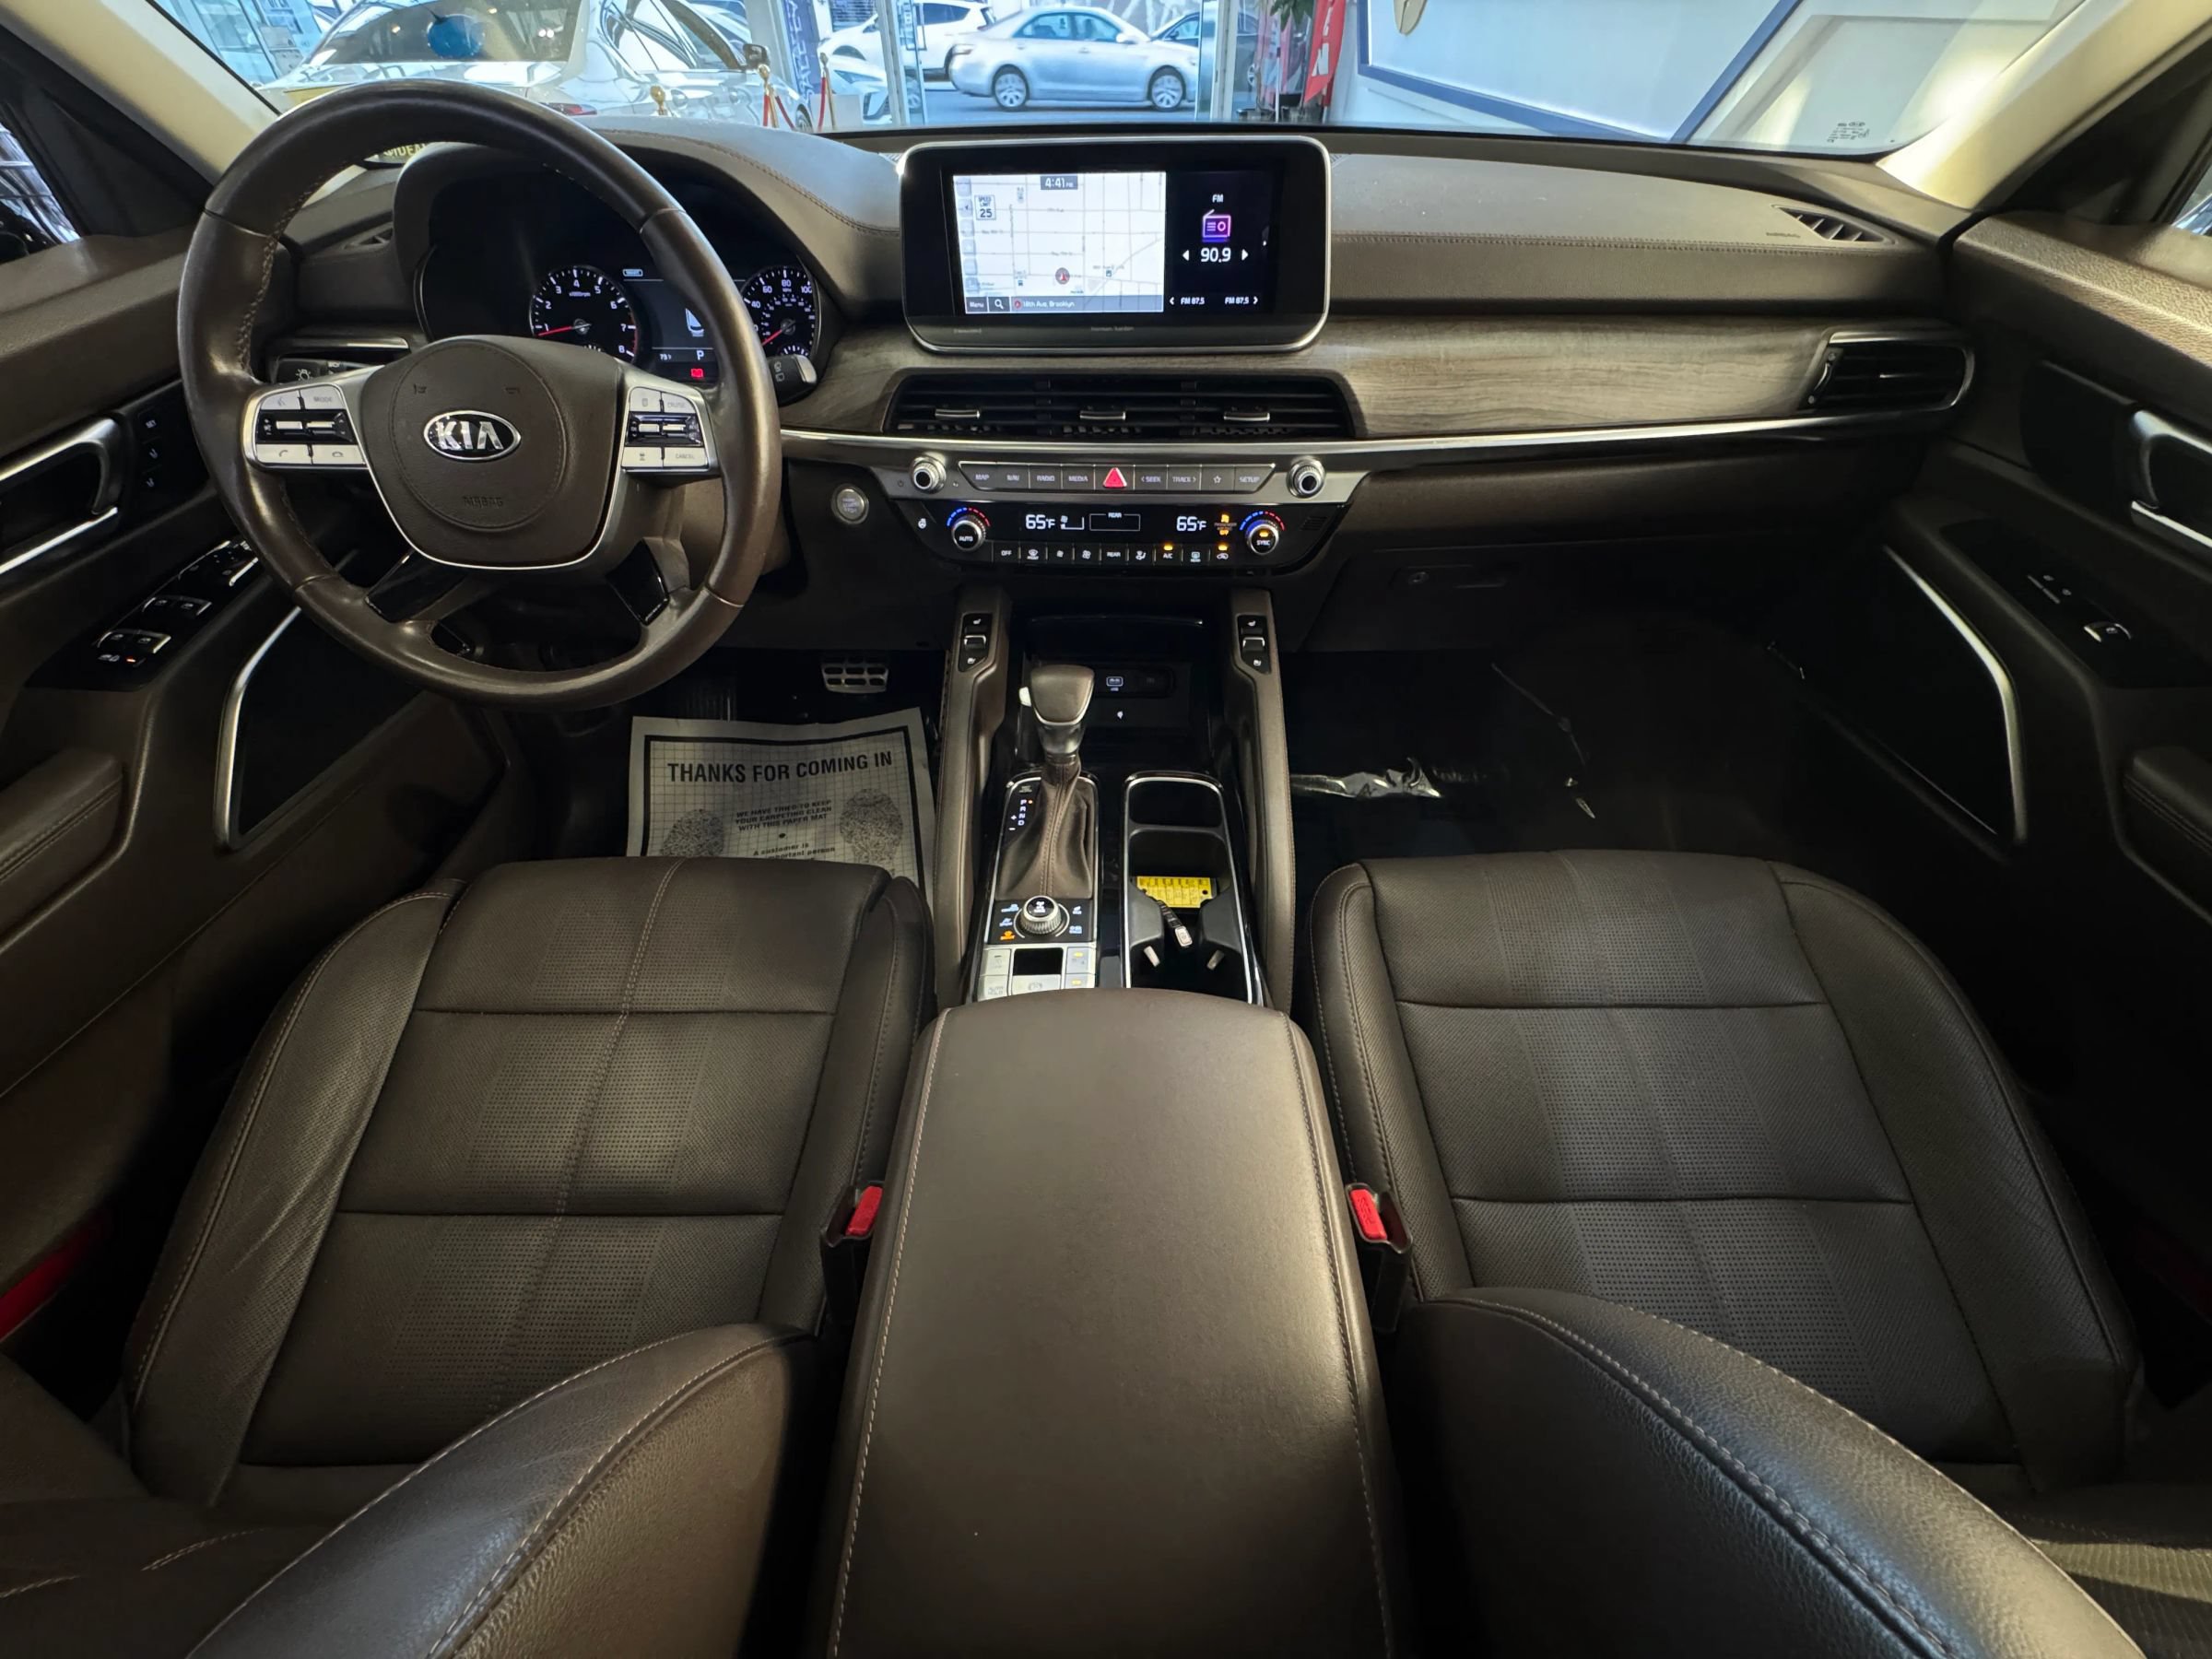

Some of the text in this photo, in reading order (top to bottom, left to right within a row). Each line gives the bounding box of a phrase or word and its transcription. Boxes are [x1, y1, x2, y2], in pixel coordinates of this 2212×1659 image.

[1045, 178, 1065, 187] 4:41
[1212, 194, 1224, 203] FM
[980, 208, 993, 218] 25
[1200, 247, 1231, 263] 90.9
[573, 279, 581, 288] 4
[555, 286, 562, 294] 3
[594, 286, 602, 294] 5
[545, 300, 552, 310] 2
[610, 300, 618, 310] 6
[751, 300, 761, 309] 40
[1049, 300, 1076, 309] Brooklyn
[1181, 297, 1205, 305] FM 87.5
[1235, 297, 1250, 305] 87.5
[620, 324, 627, 332] 7
[618, 345, 625, 353] 8
[696, 350, 705, 360] P
[436, 420, 504, 452] KIA
[667, 751, 892, 782] THANKS FOR COMING IN
[735, 806, 831, 825] YOUR CARPETING CLEAN
[738, 823, 760, 831] WITH
[782, 817, 808, 826] PAPER
[761, 844, 799, 855] customer
[807, 847, 835, 856] person
